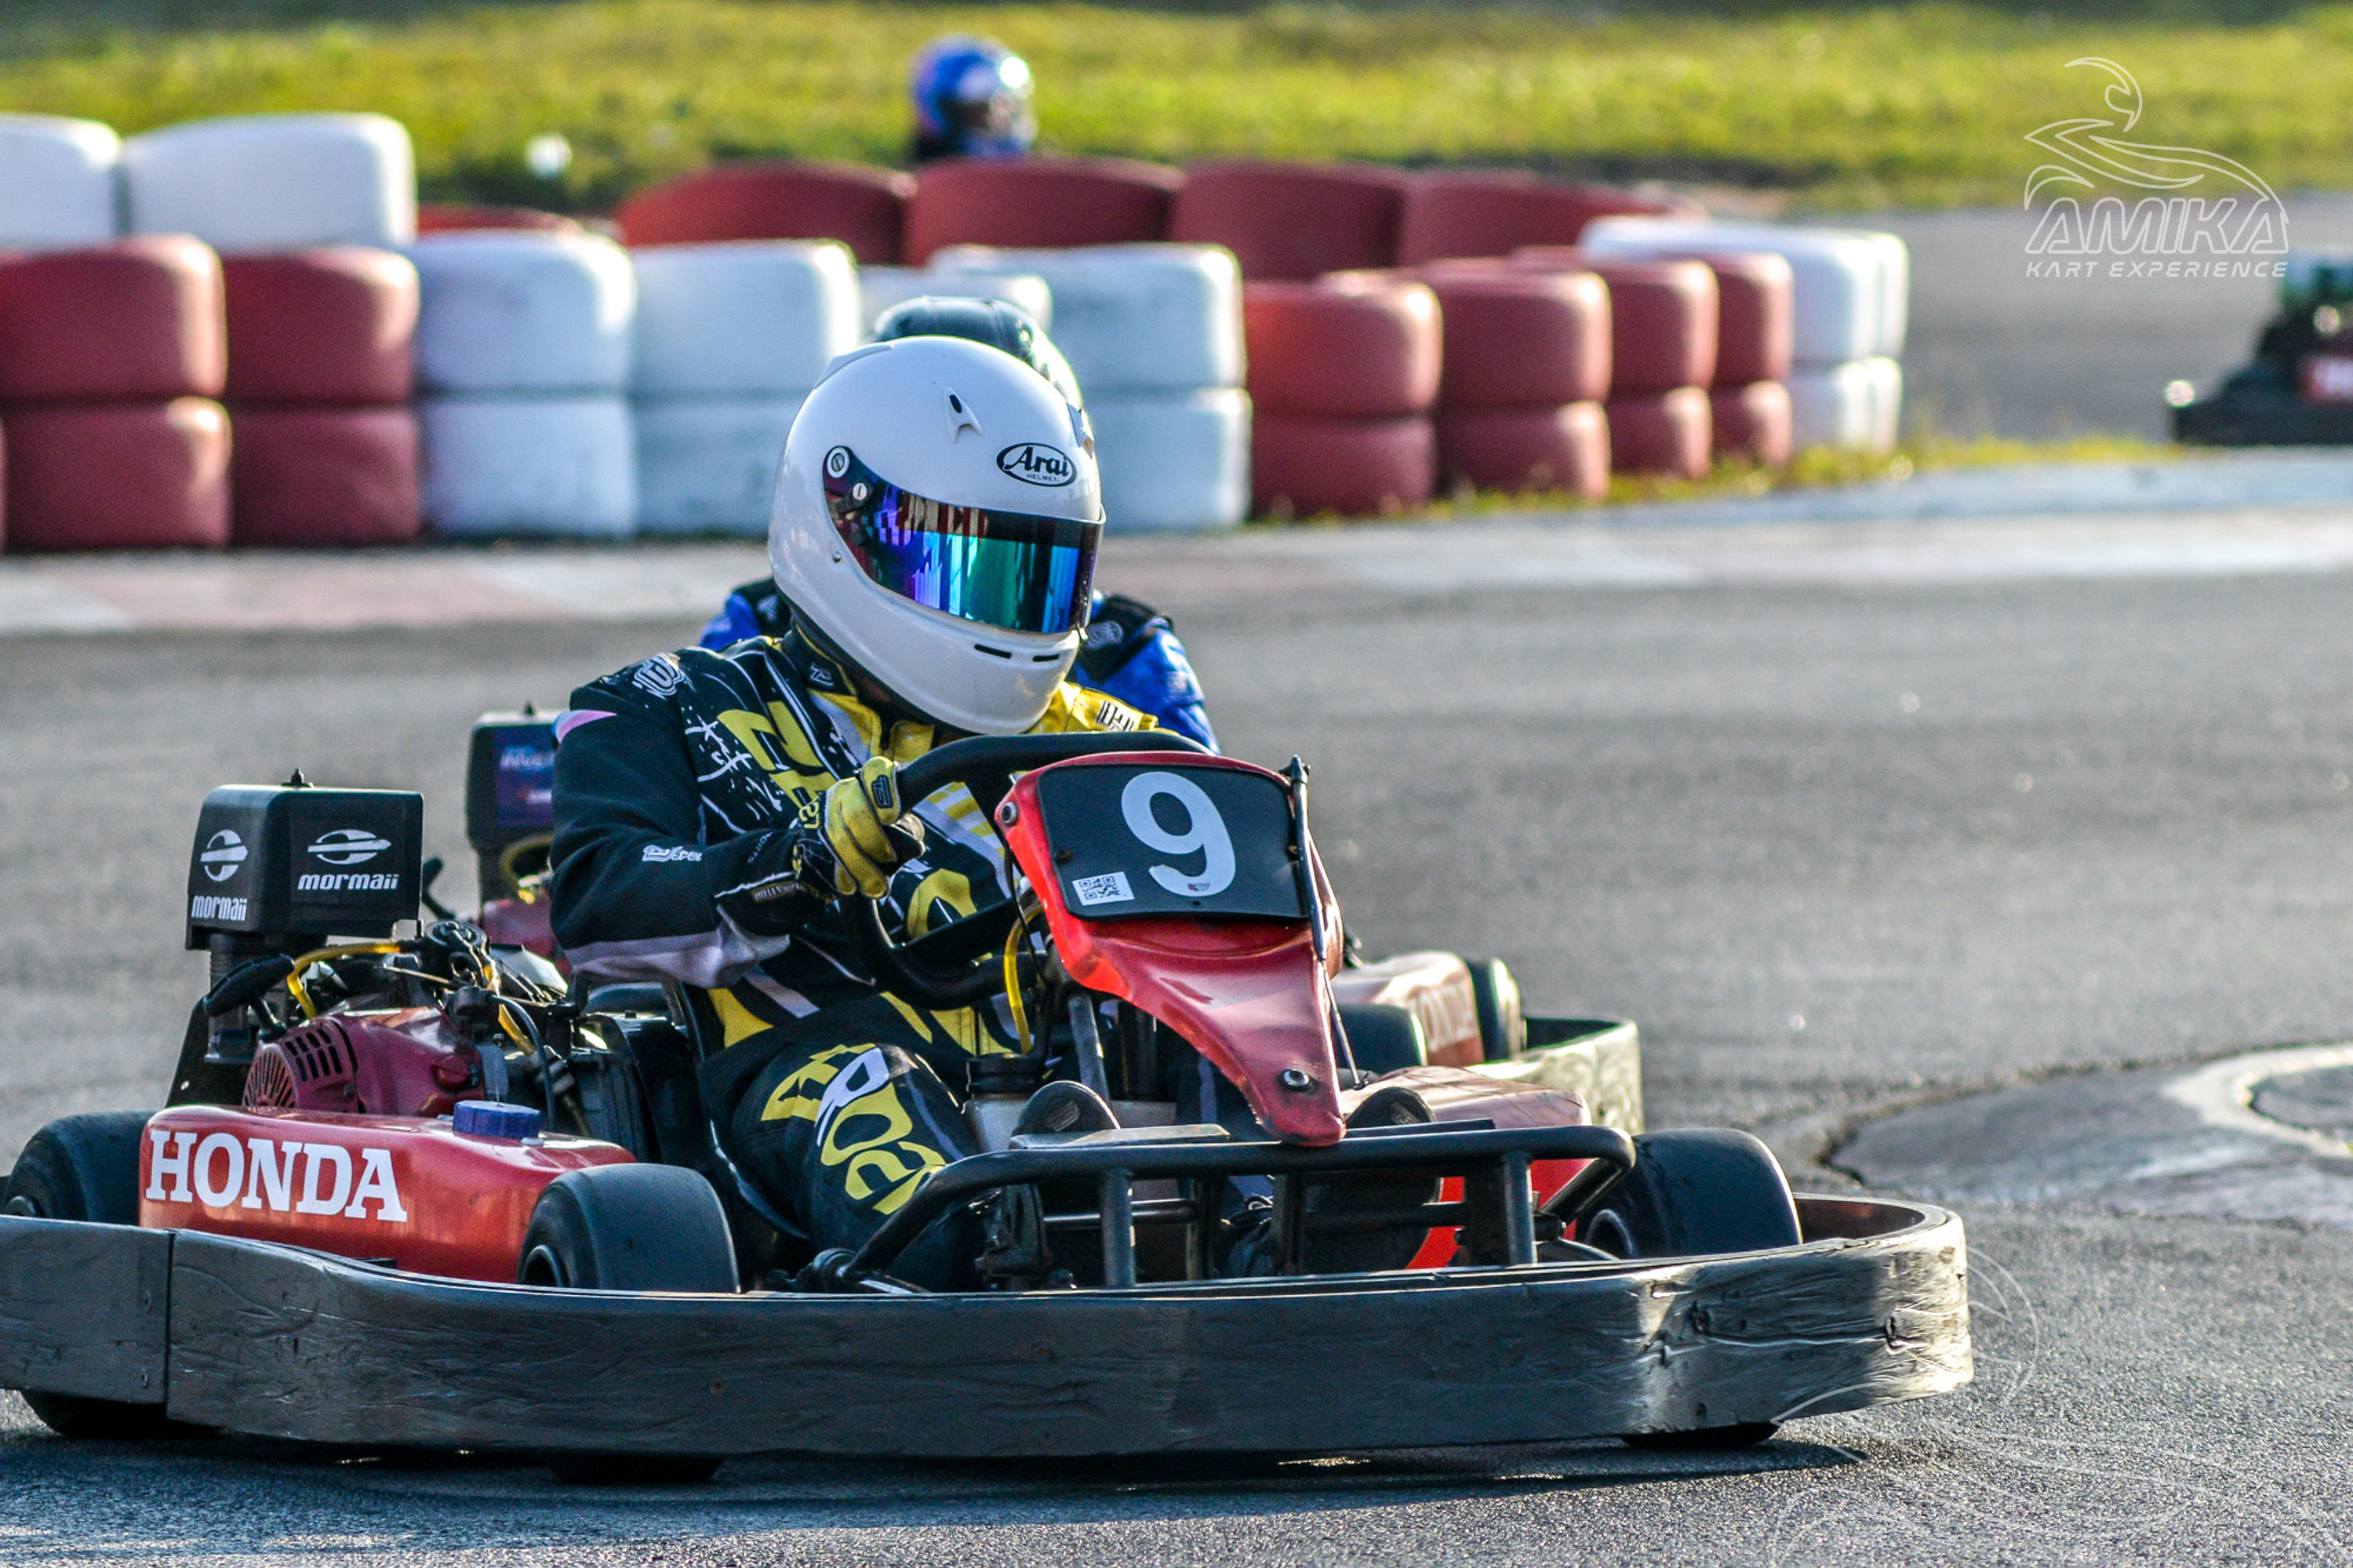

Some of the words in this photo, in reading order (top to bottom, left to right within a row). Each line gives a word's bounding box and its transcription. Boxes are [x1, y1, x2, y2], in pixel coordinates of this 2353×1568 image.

[1004, 446, 1069, 477] Arai
[1121, 771, 1236, 897] 9
[297, 873, 399, 890] mormaii
[191, 894, 248, 922] mormaii
[145, 1130, 407, 1222] HONDA
